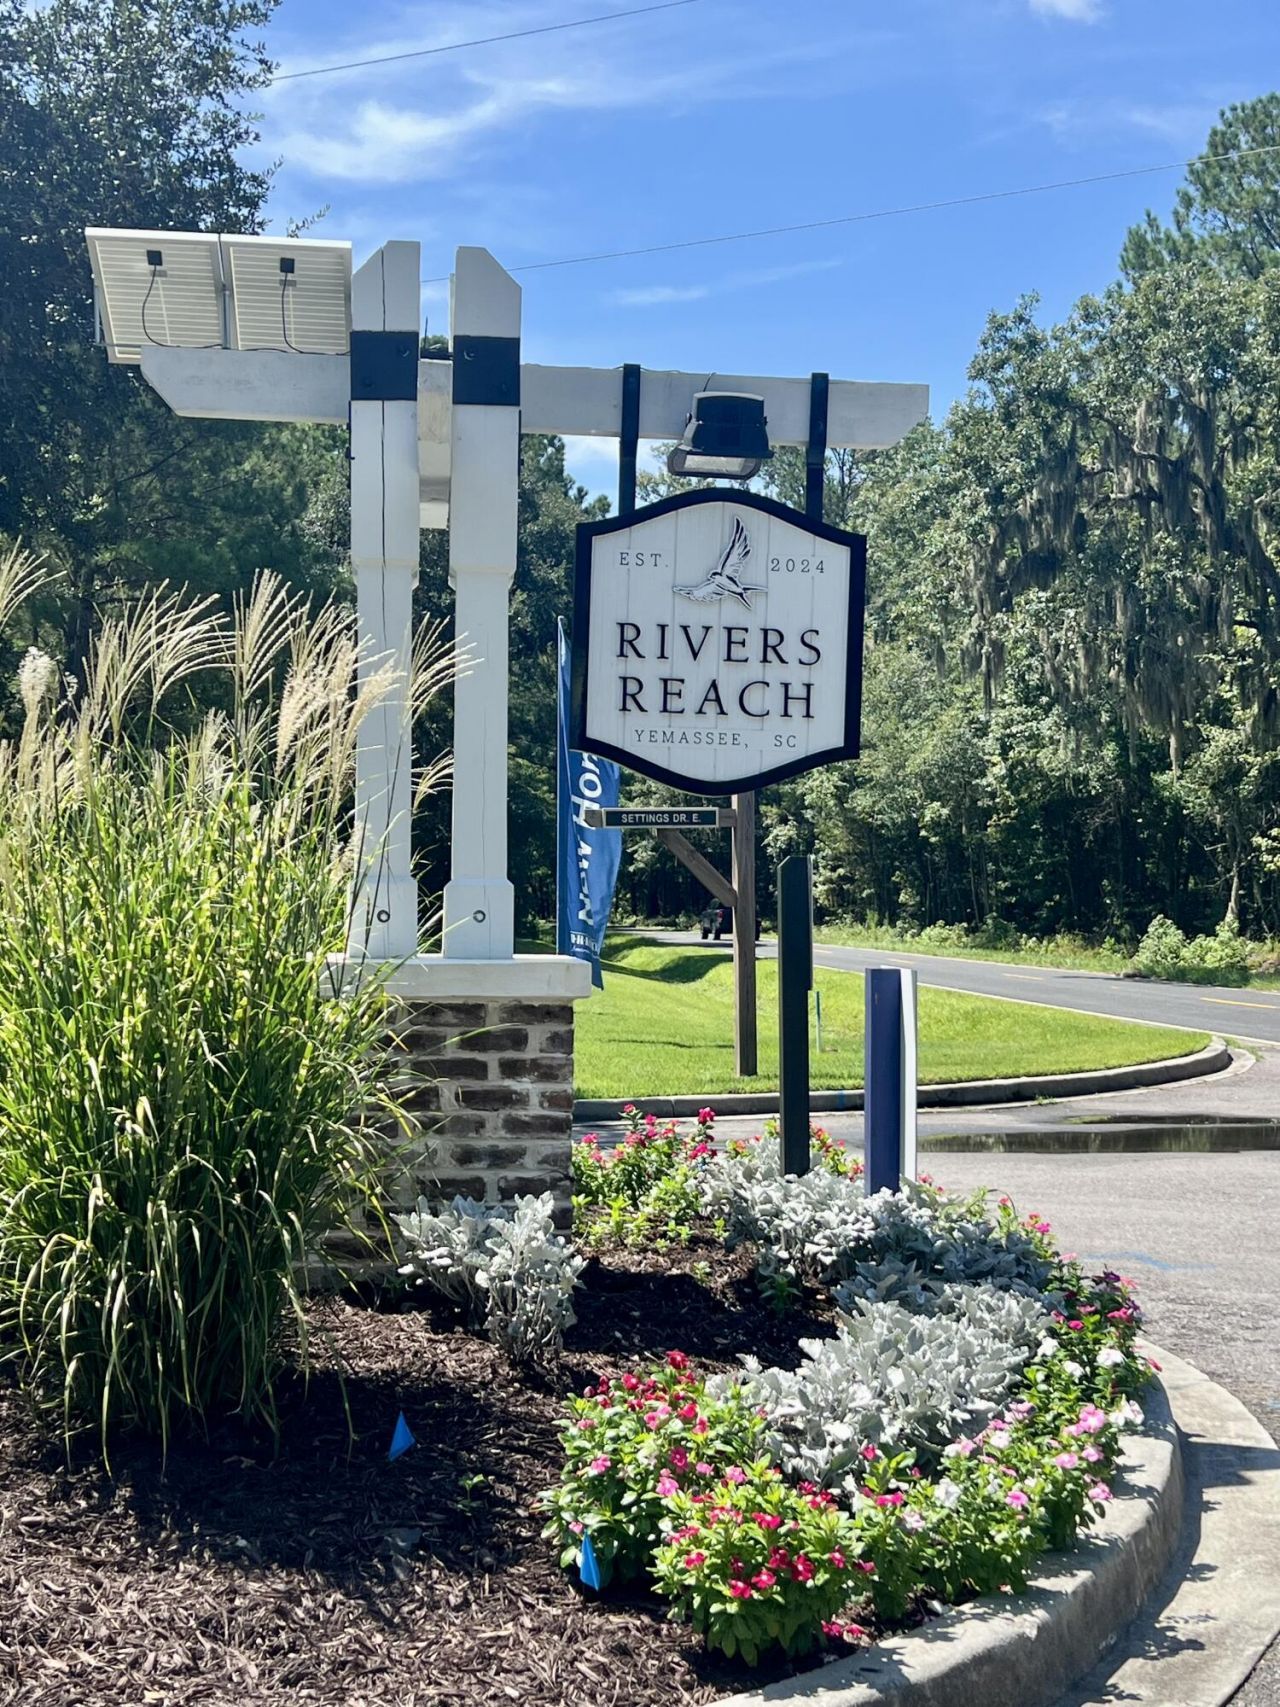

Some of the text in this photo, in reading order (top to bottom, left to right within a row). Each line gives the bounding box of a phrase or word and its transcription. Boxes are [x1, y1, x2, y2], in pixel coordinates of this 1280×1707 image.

[618, 552, 826, 574] EST. 2024
[615, 622, 822, 666] RIVERS
[618, 675, 816, 719] REACH
[634, 729, 797, 749] YEMASSEE, SC
[621, 813, 670, 823] SETTINGS
